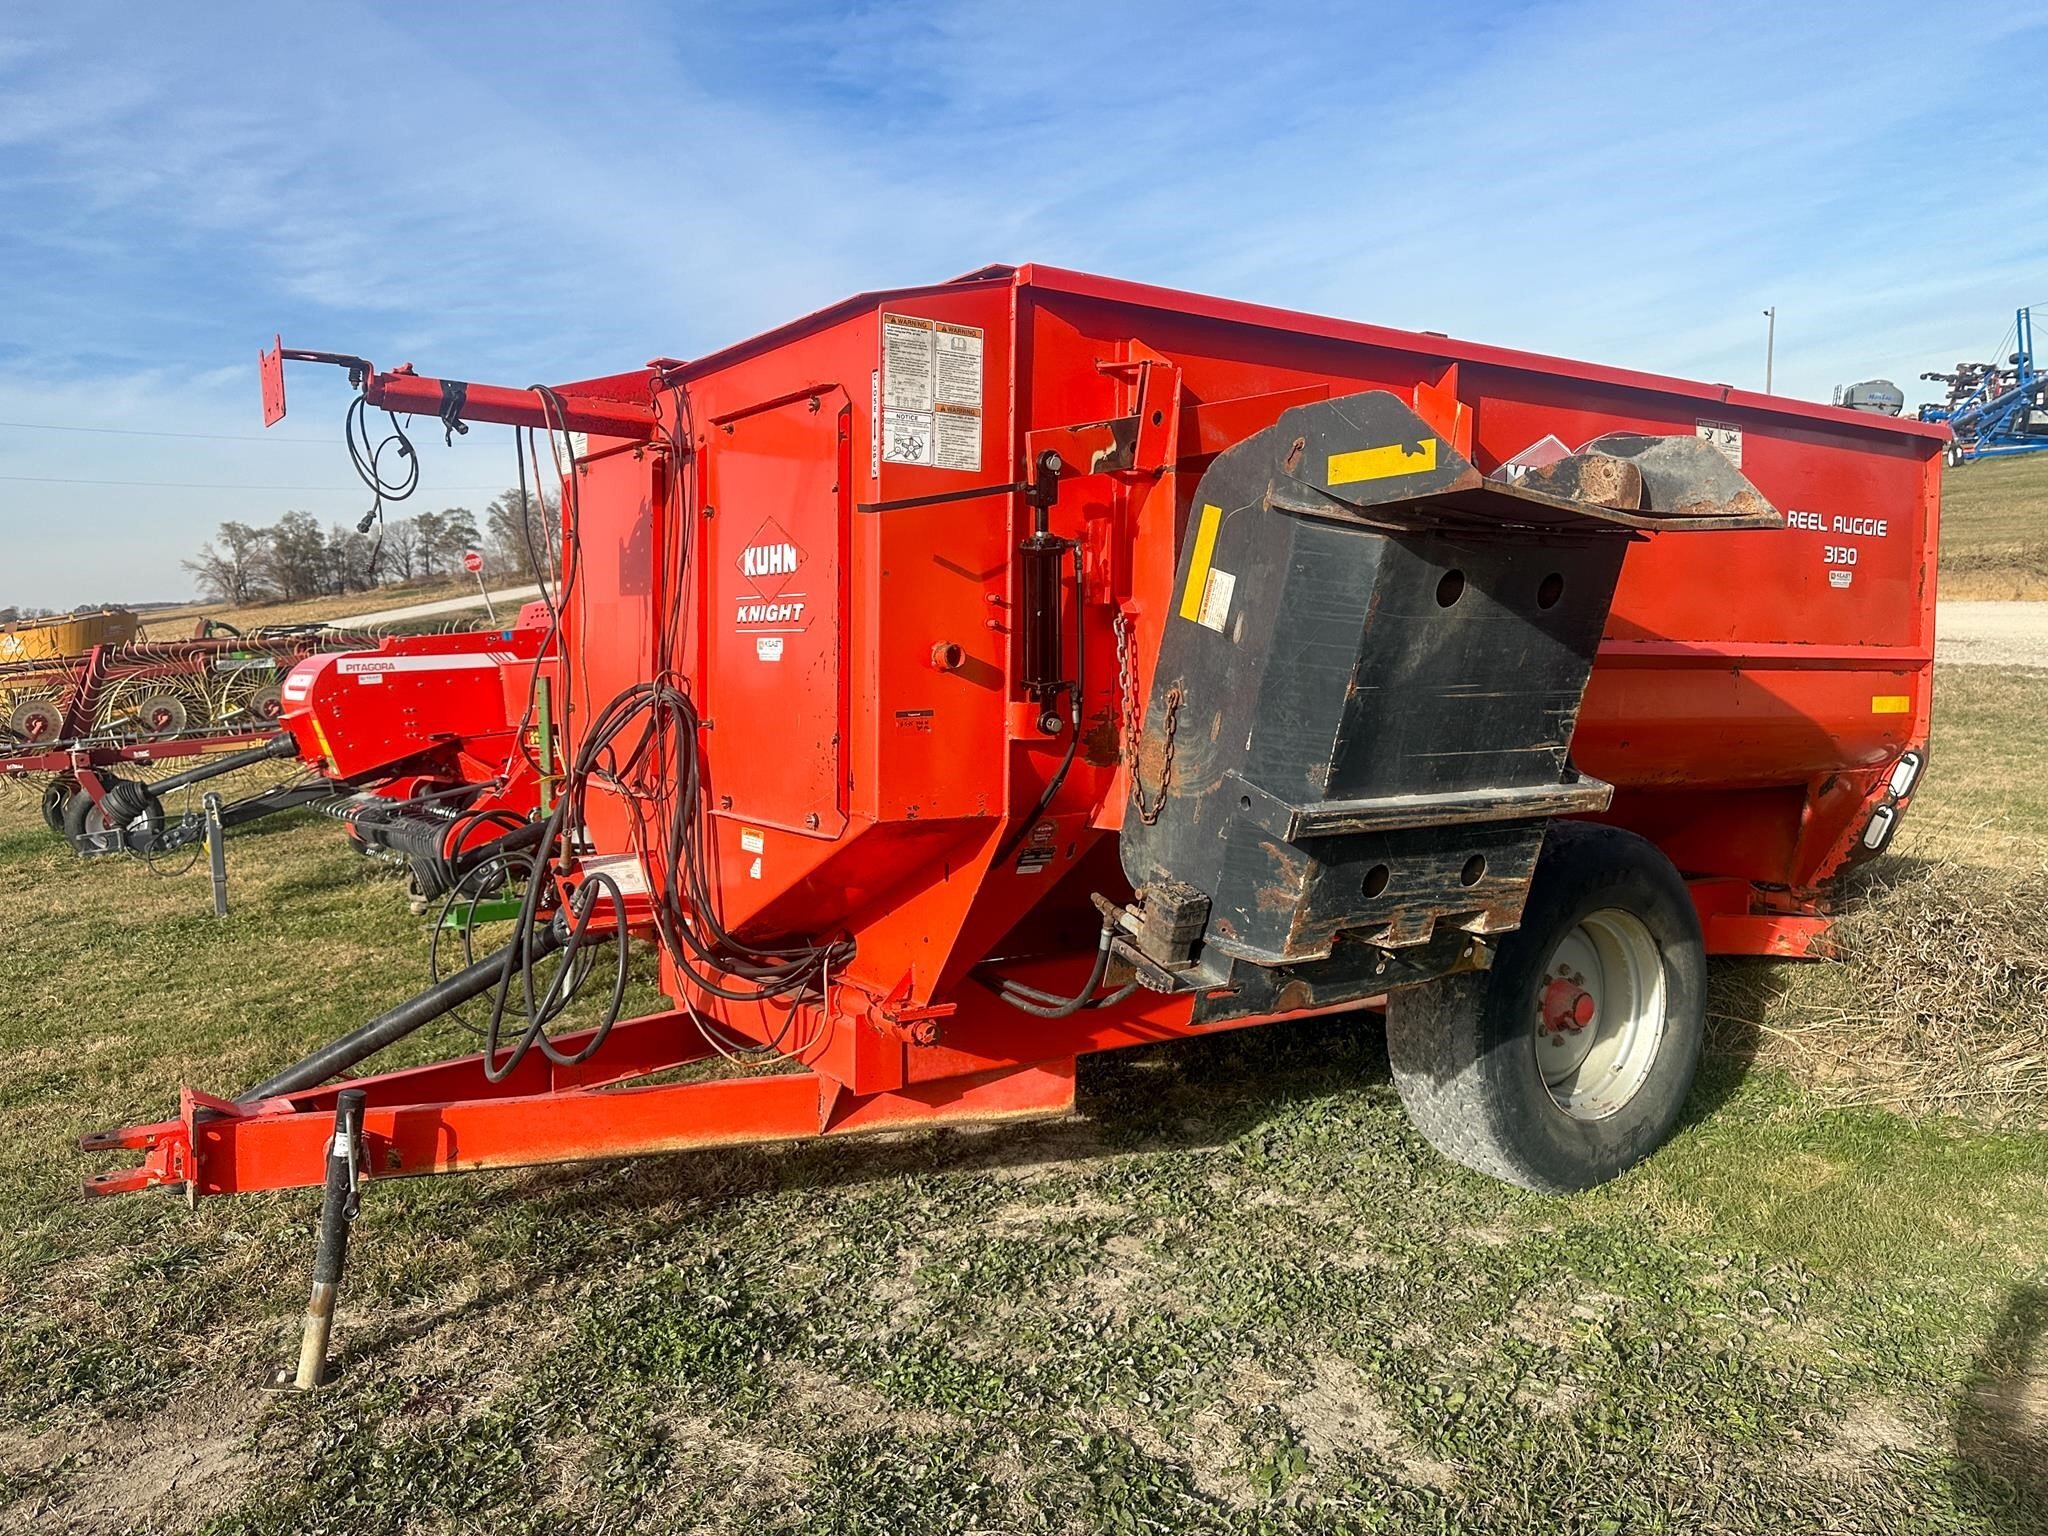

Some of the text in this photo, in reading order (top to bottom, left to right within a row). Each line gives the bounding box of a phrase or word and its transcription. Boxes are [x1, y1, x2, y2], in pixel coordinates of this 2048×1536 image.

[897, 318, 927, 328] WARNING
[948, 327, 977, 337] WARNING
[946, 406, 975, 416] WARNING
[896, 413, 919, 421] NOTICE
[1787, 509, 1888, 537] REEL AUGGIE
[744, 543, 798, 577] KUHN
[1823, 545, 1857, 565] 3130
[736, 603, 805, 623] KNIGHT
[345, 662, 396, 672] PITAGORA
